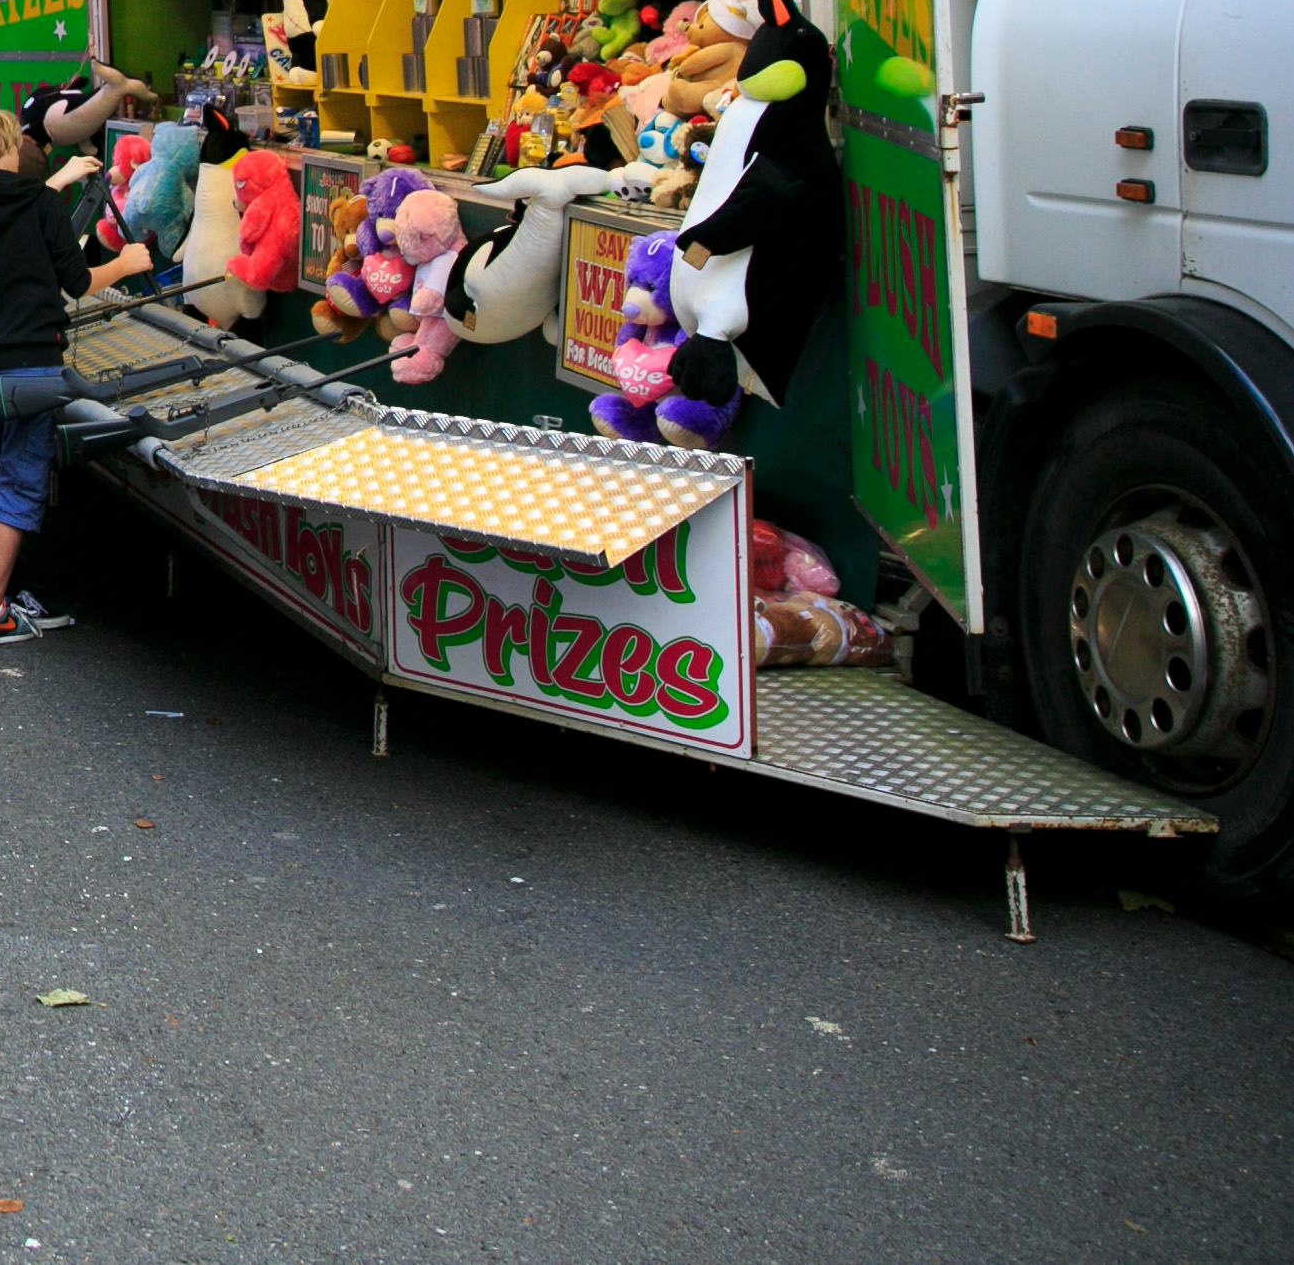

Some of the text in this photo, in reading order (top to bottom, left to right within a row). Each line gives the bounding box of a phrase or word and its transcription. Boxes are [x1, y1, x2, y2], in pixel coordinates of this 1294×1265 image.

[575, 257, 626, 315] WI
[848, 179, 944, 384] PLUSH
[566, 338, 586, 364] FOR
[620, 381, 652, 397] you
[865, 354, 940, 531] TOYS
[399, 553, 729, 730] Prizes
